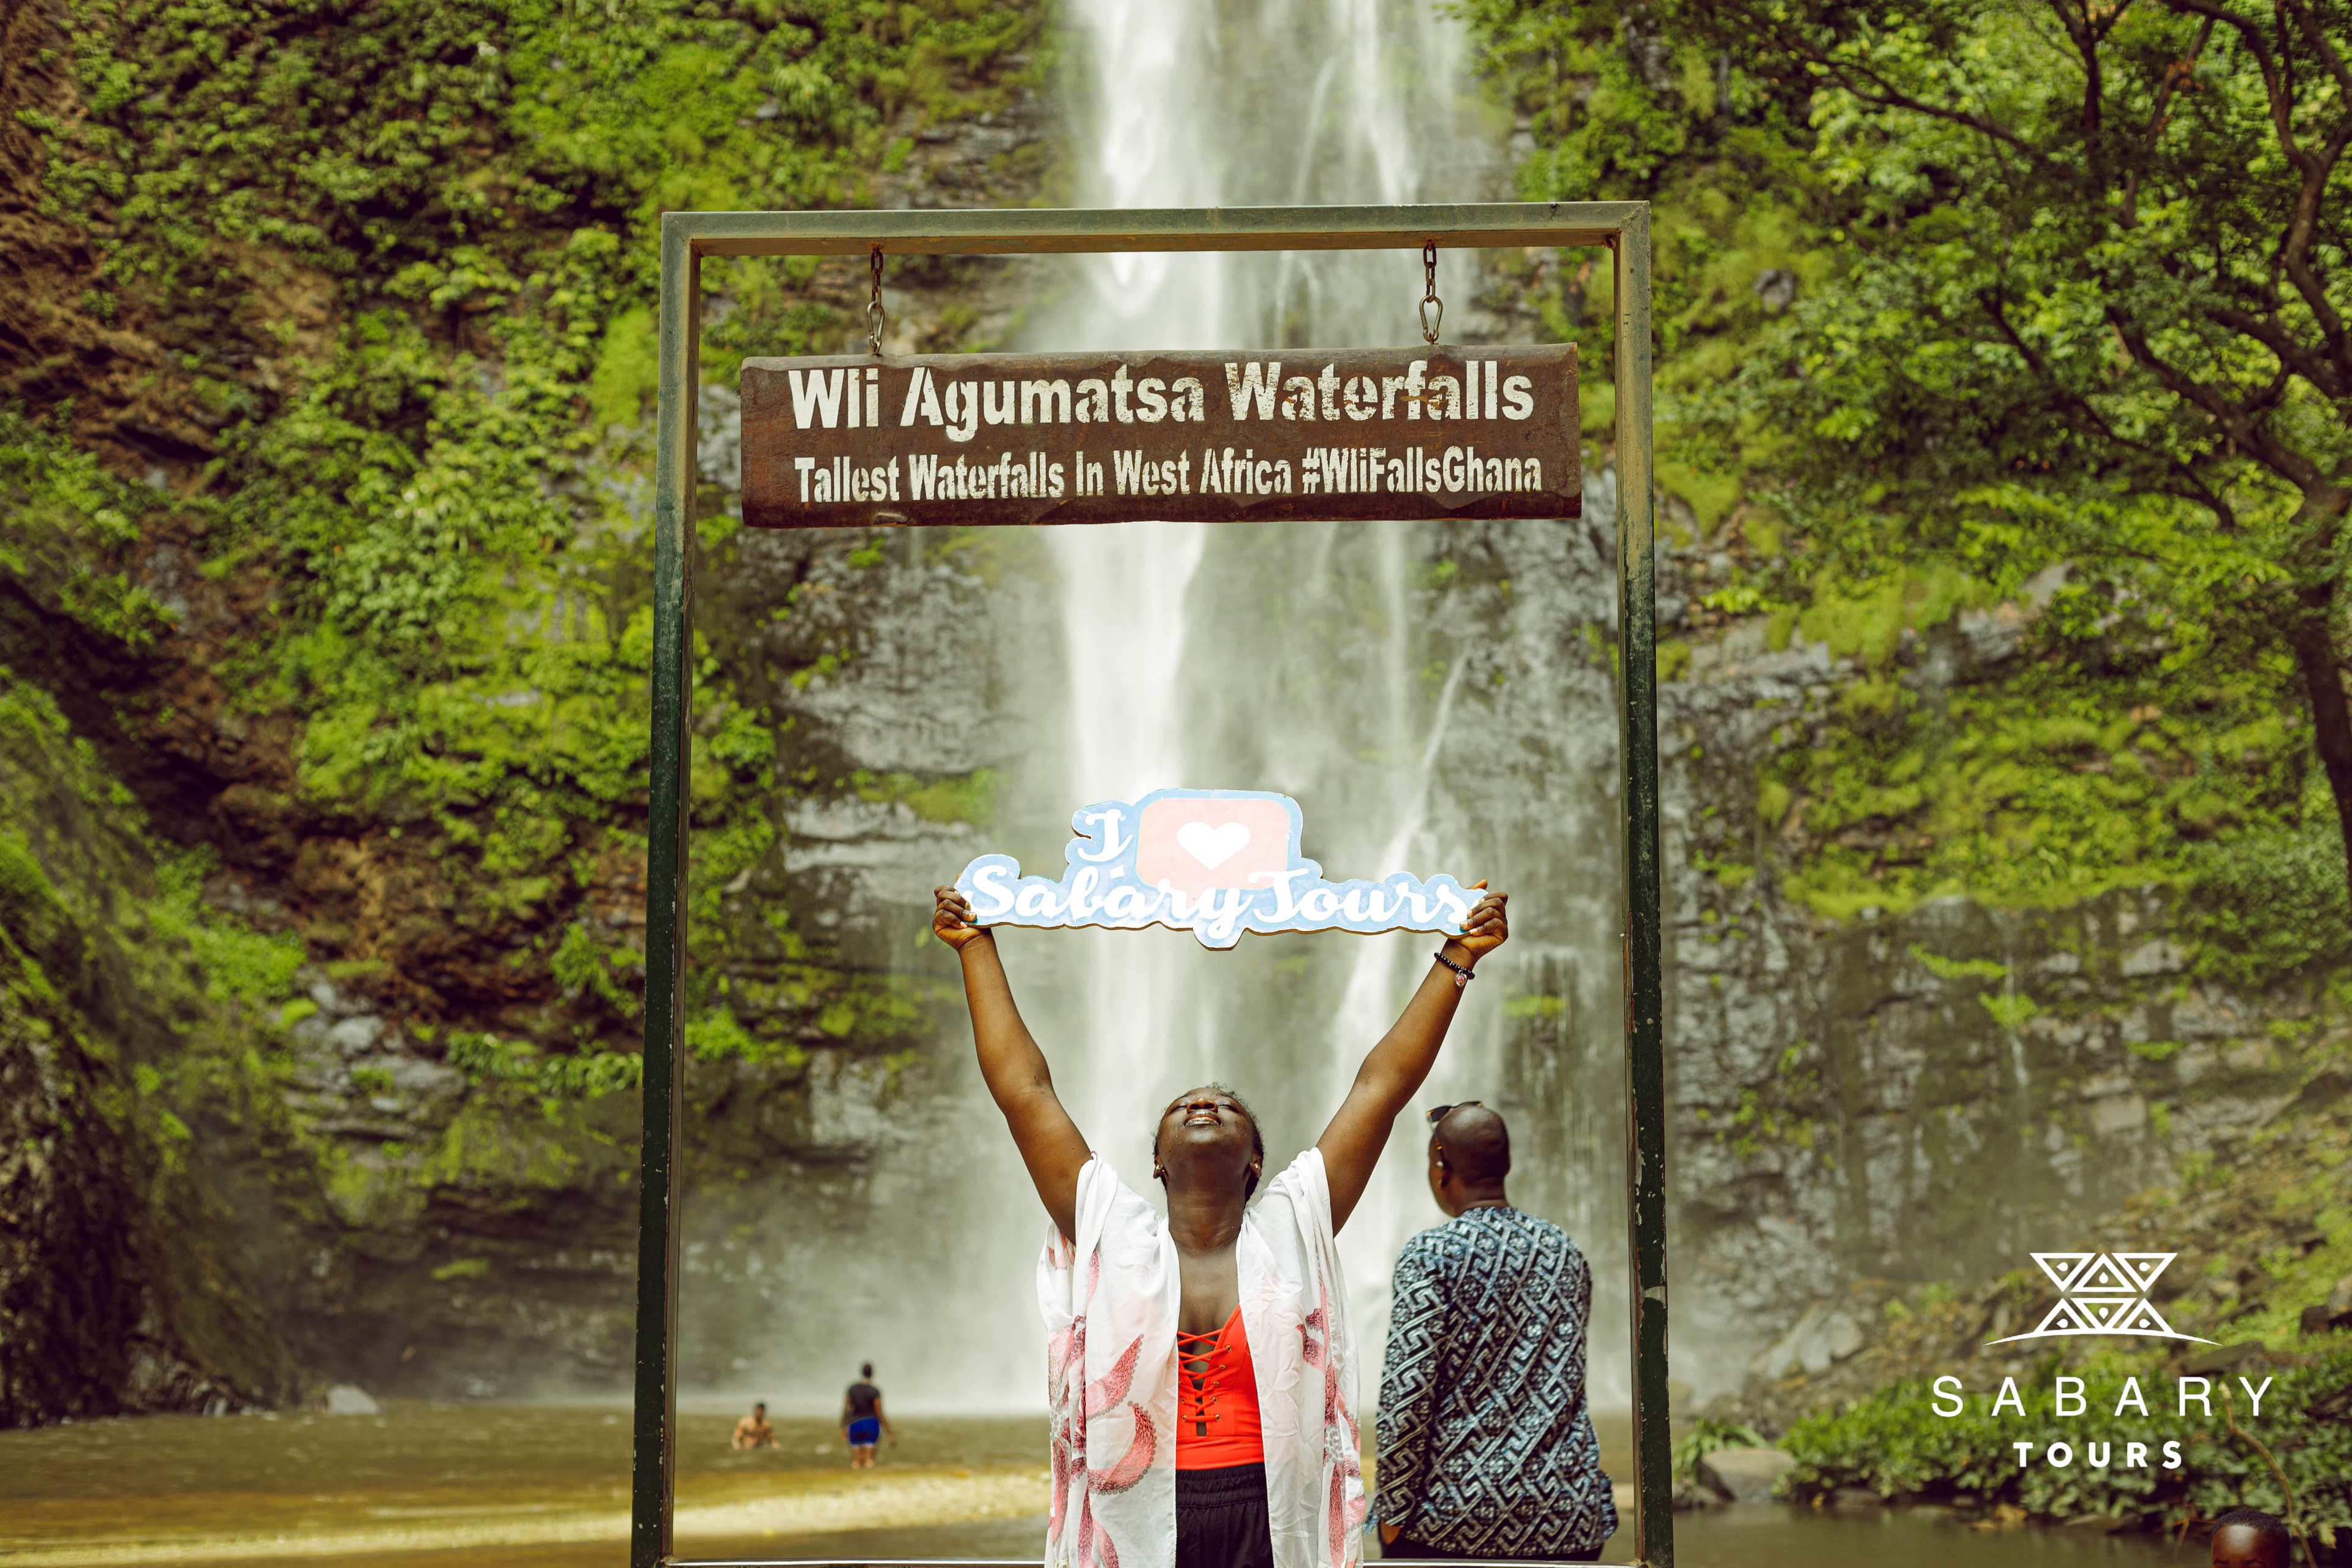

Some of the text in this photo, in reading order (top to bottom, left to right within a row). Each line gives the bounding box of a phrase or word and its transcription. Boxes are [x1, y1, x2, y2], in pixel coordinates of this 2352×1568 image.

[788, 360, 1534, 442] Wli Agumatsa Waterfalls
[794, 446, 1542, 503] Tallest Waterfalls In West Africa #WliFallsGhana
[1077, 809, 1133, 861] I
[961, 865, 1485, 939] Sabary Tours
